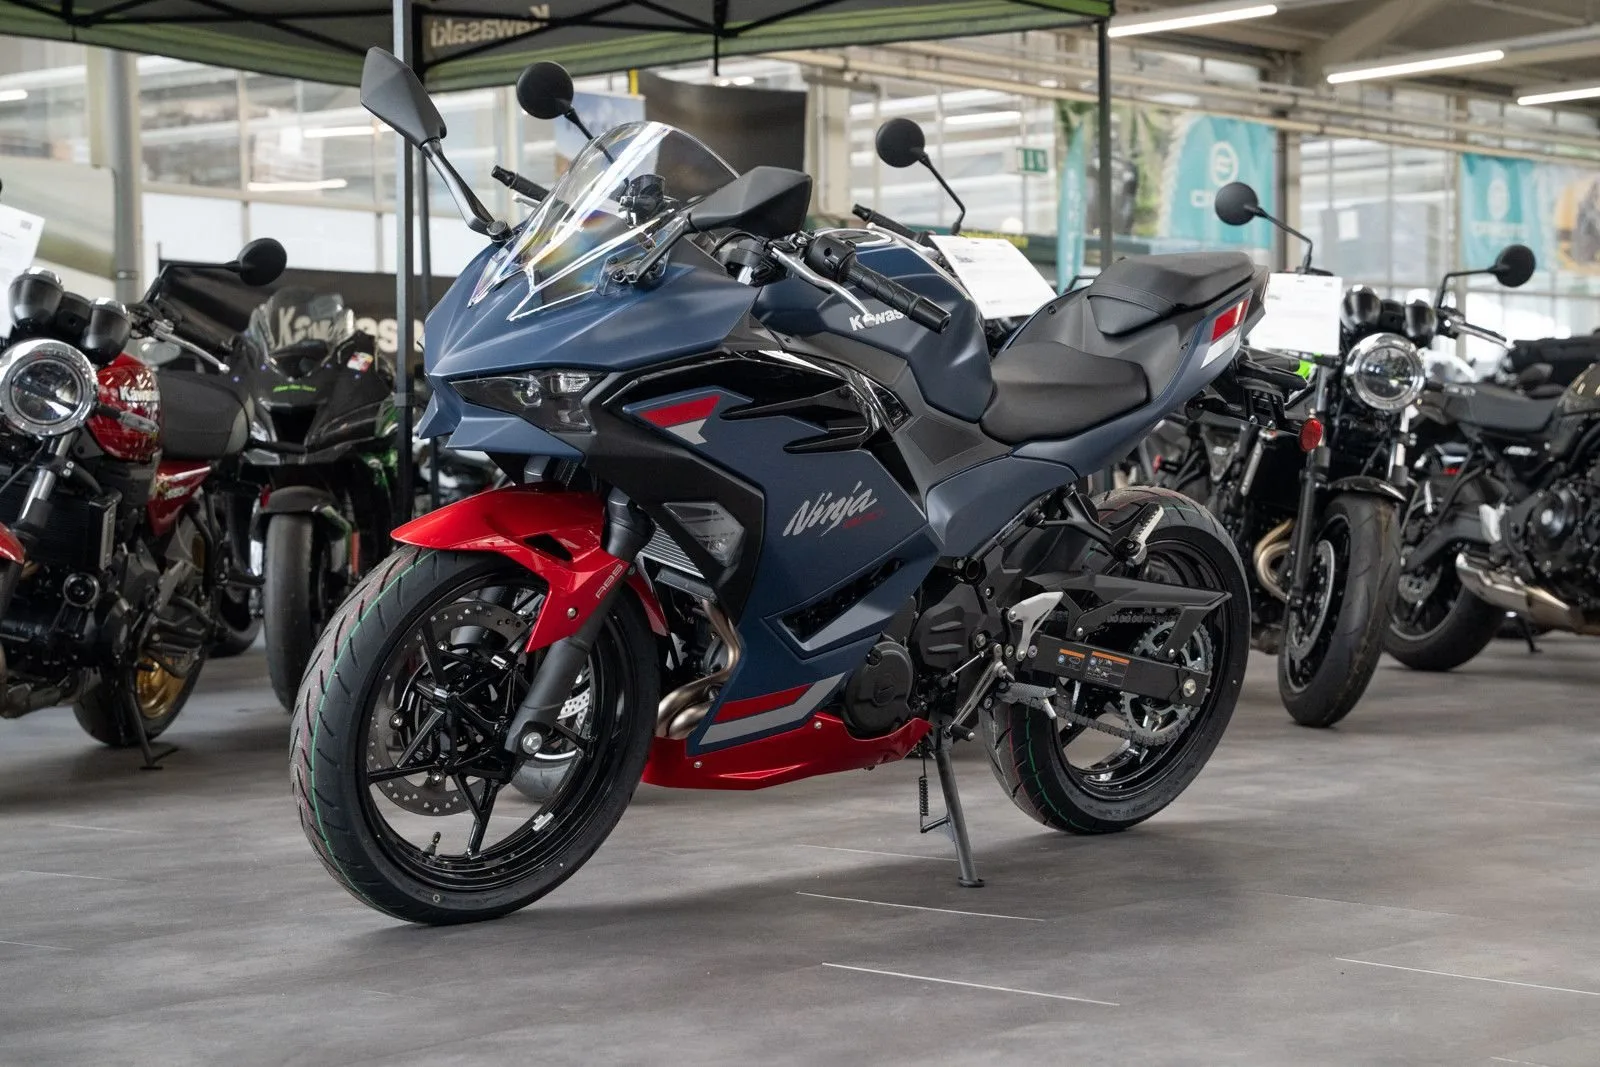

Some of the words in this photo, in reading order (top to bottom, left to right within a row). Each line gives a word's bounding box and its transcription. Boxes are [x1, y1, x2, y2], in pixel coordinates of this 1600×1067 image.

[849, 309, 906, 331] Kwas
[782, 480, 878, 537] Ninja
[595, 563, 623, 599] ABS
